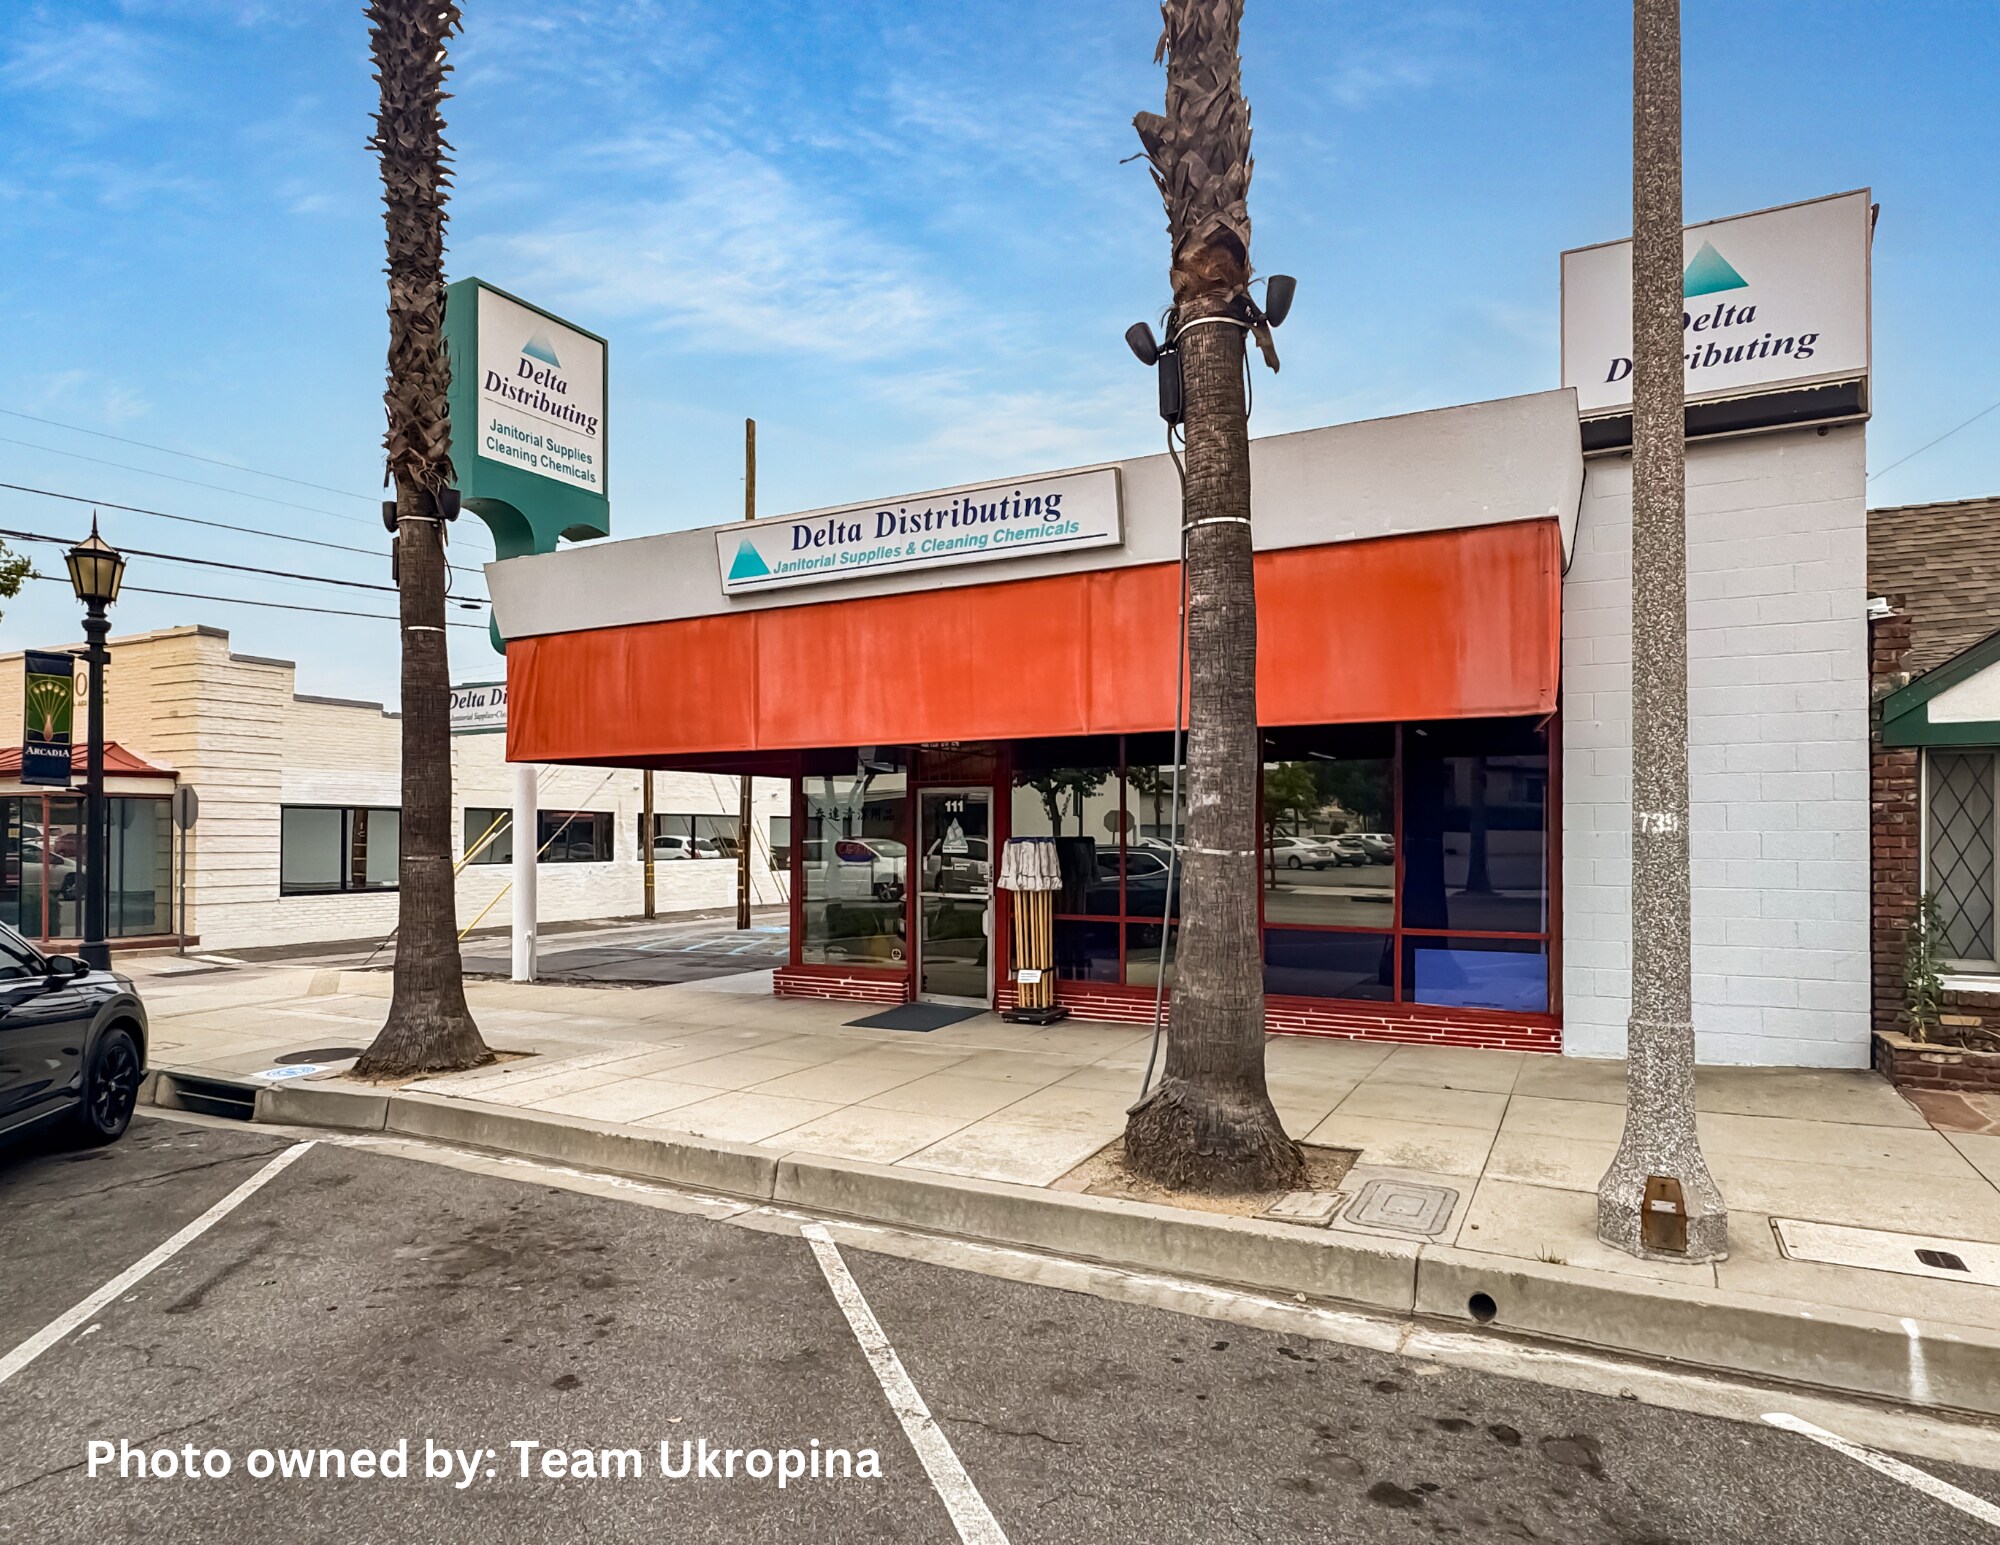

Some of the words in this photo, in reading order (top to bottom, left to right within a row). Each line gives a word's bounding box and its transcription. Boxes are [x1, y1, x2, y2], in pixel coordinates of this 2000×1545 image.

[1683, 303, 1757, 333] elta
[517, 357, 568, 395] Delta
[484, 370, 598, 436] Distributing
[486, 436, 537, 467] Cleaning
[540, 455, 597, 483] Chemicals
[489, 418, 543, 448] Janitorial
[546, 438, 593, 465] Supplies
[791, 519, 863, 551] Delta
[874, 490, 1063, 539] Distributing
[773, 553, 836, 574] Janitorial
[839, 545, 901, 565] Supplies
[906, 541, 917, 556] &
[921, 532, 989, 553] Cleaning
[993, 520, 1080, 544] Chemicals
[450, 691, 486, 709] Delta
[25, 745, 70, 758] ARCADIA
[944, 800, 964, 812] 111
